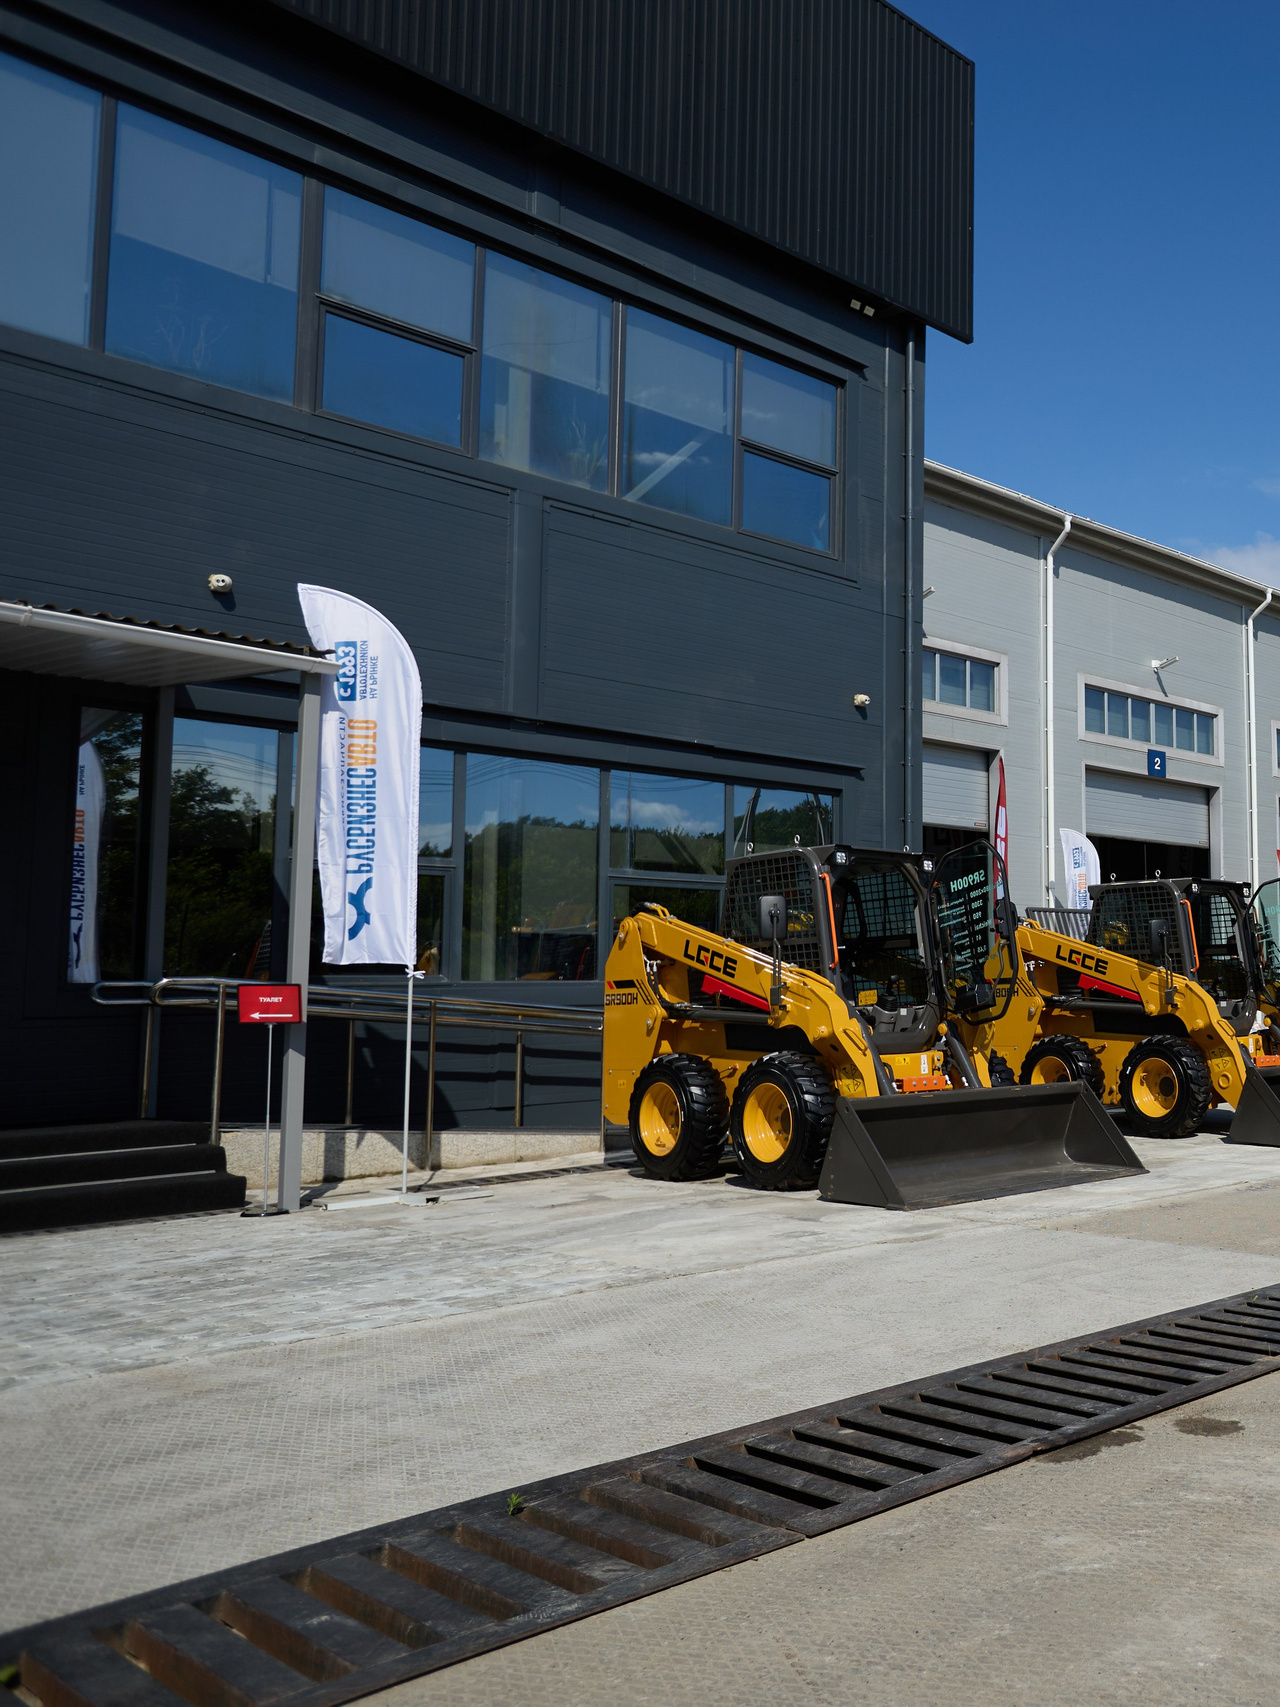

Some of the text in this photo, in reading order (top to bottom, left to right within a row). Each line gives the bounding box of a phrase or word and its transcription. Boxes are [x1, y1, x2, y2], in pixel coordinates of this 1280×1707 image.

[1154, 757, 1161, 770] 2
[683, 939, 738, 979] LGCE
[1055, 944, 1109, 976] LGCE
[605, 992, 639, 1006] SR900H
